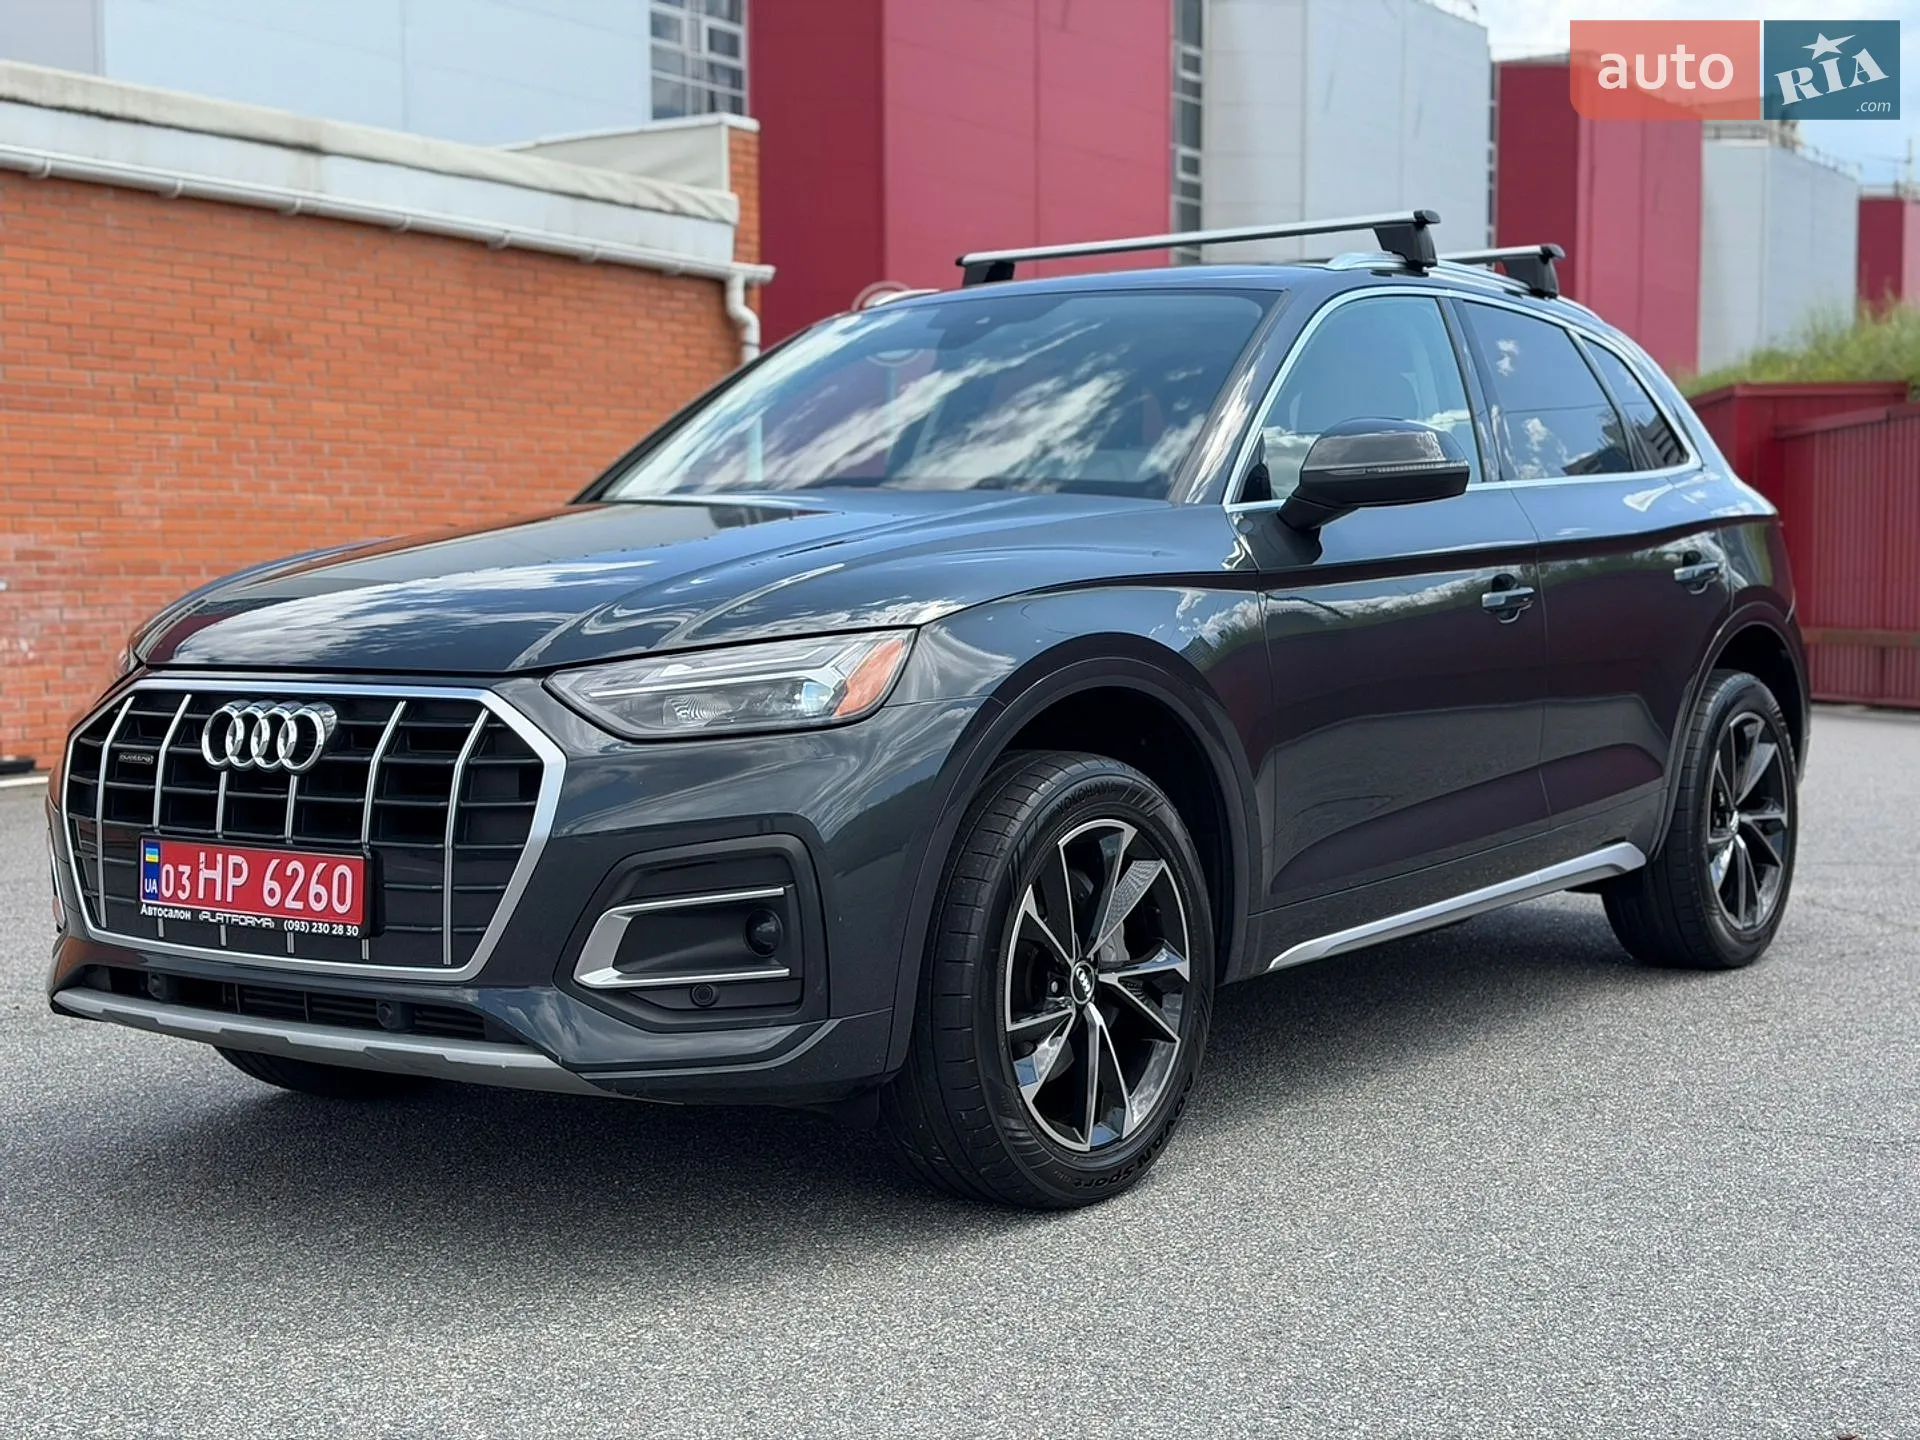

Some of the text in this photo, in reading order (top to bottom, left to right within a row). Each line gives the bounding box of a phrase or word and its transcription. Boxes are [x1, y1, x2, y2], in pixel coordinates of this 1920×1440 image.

[144, 878, 158, 894] UA
[161, 851, 353, 914] 03 HP 6260
[140, 903, 192, 920] Автосалон
[283, 919, 310, 934] (093)
[311, 922, 330, 935] 230
[331, 924, 344, 936] 28
[345, 925, 359, 937] 30
